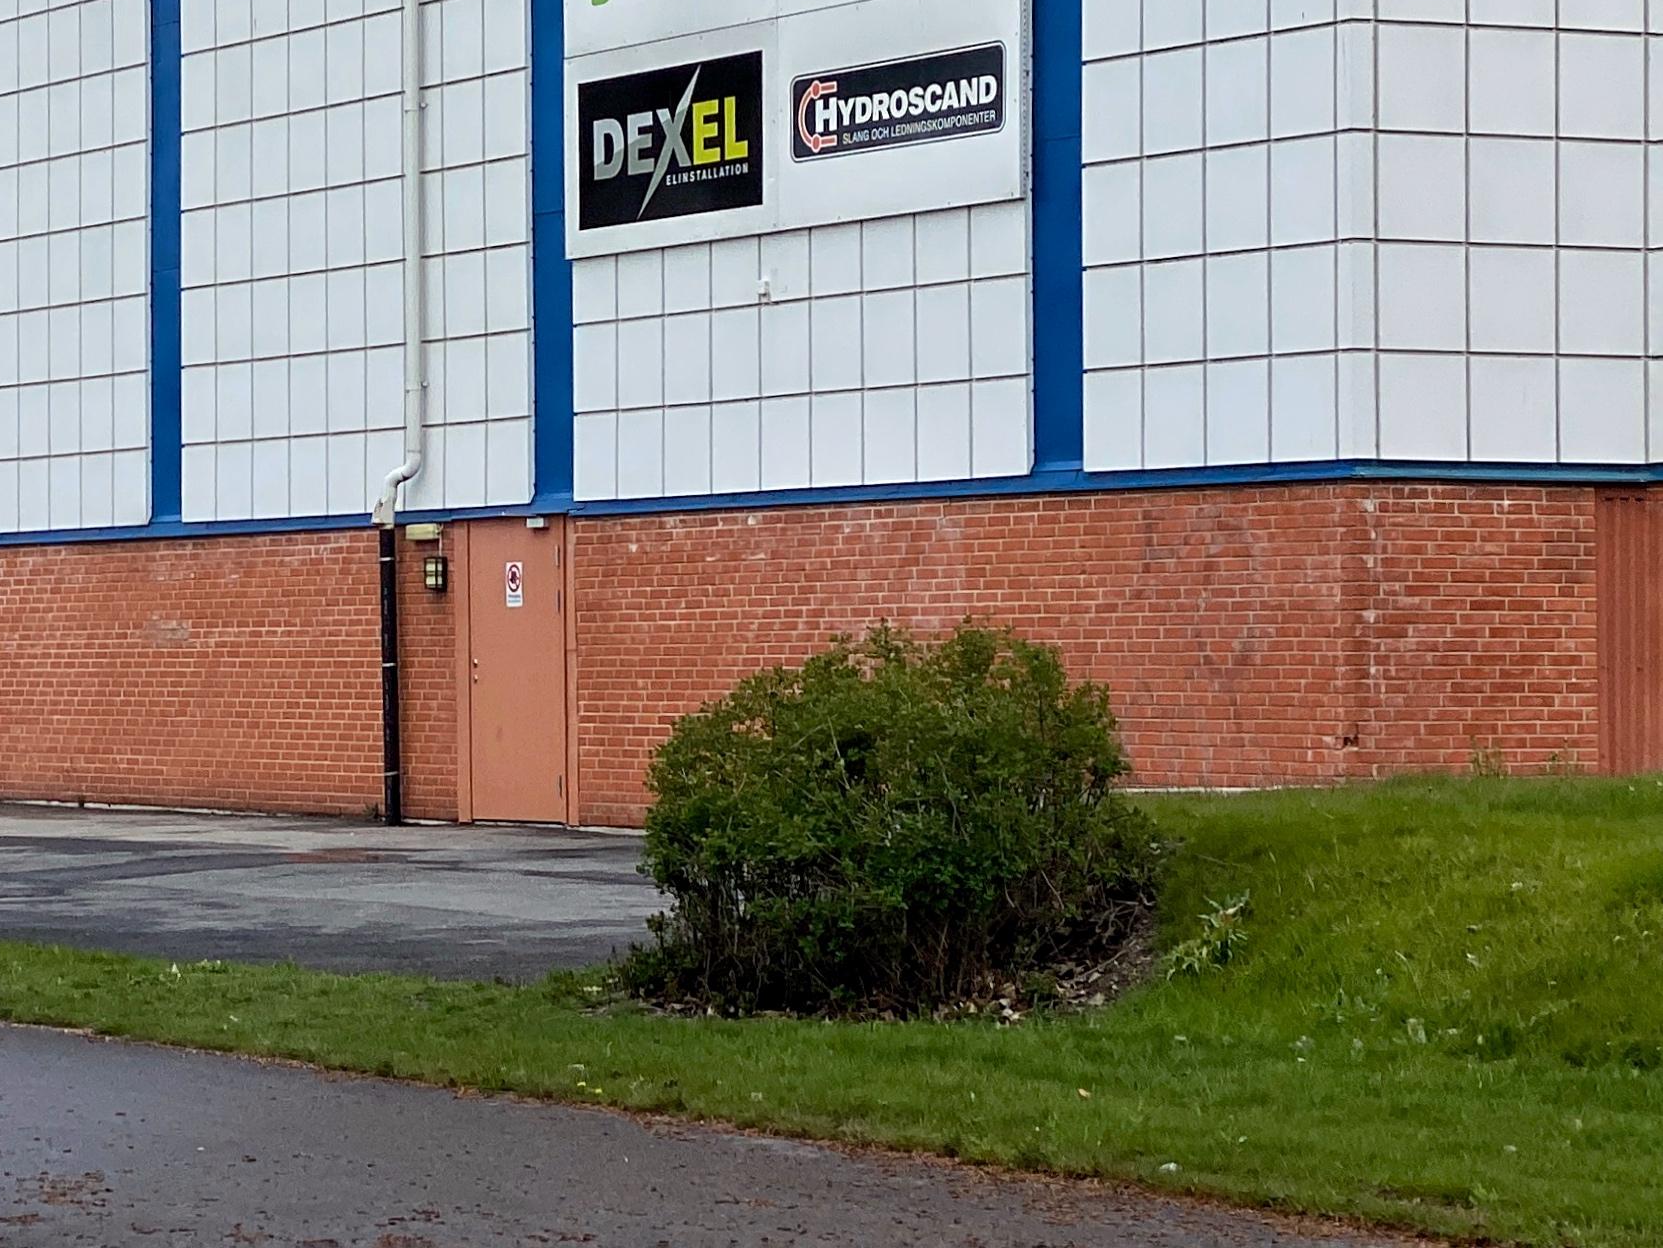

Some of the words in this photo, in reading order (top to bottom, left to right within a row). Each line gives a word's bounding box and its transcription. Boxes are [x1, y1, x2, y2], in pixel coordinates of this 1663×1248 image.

[814, 74, 998, 134] HYDROSCAND
[842, 129, 870, 145] SLANG
[871, 127, 891, 142] OCH
[891, 109, 997, 138] LEDNINGSKOMPONENTER
[593, 64, 749, 220] DEXEL
[665, 161, 749, 186] ELINSTALLATION
